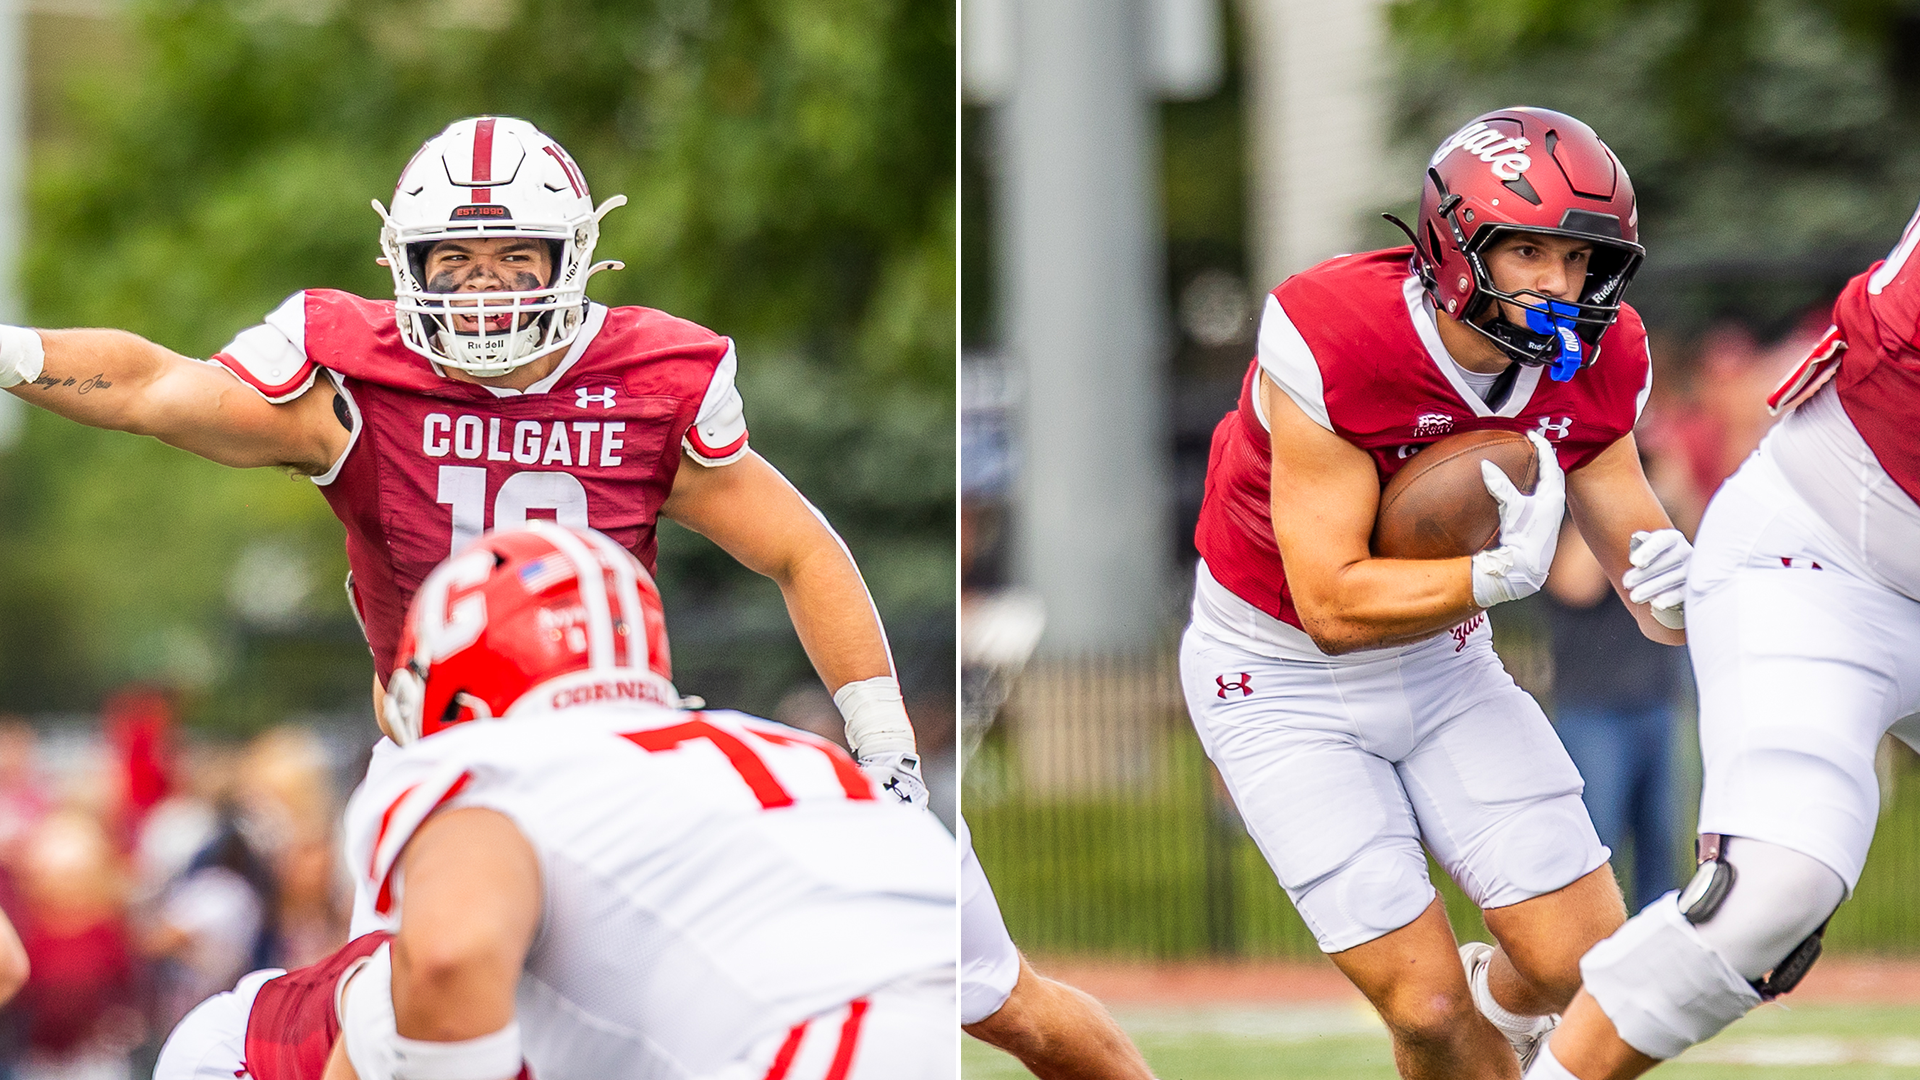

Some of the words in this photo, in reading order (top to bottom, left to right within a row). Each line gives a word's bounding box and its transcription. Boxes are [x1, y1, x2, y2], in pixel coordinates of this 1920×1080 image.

[479, 207, 504, 216] 1890
[422, 413, 626, 467] COLGATE
[413, 550, 495, 664] C
[616, 713, 876, 809] 77
